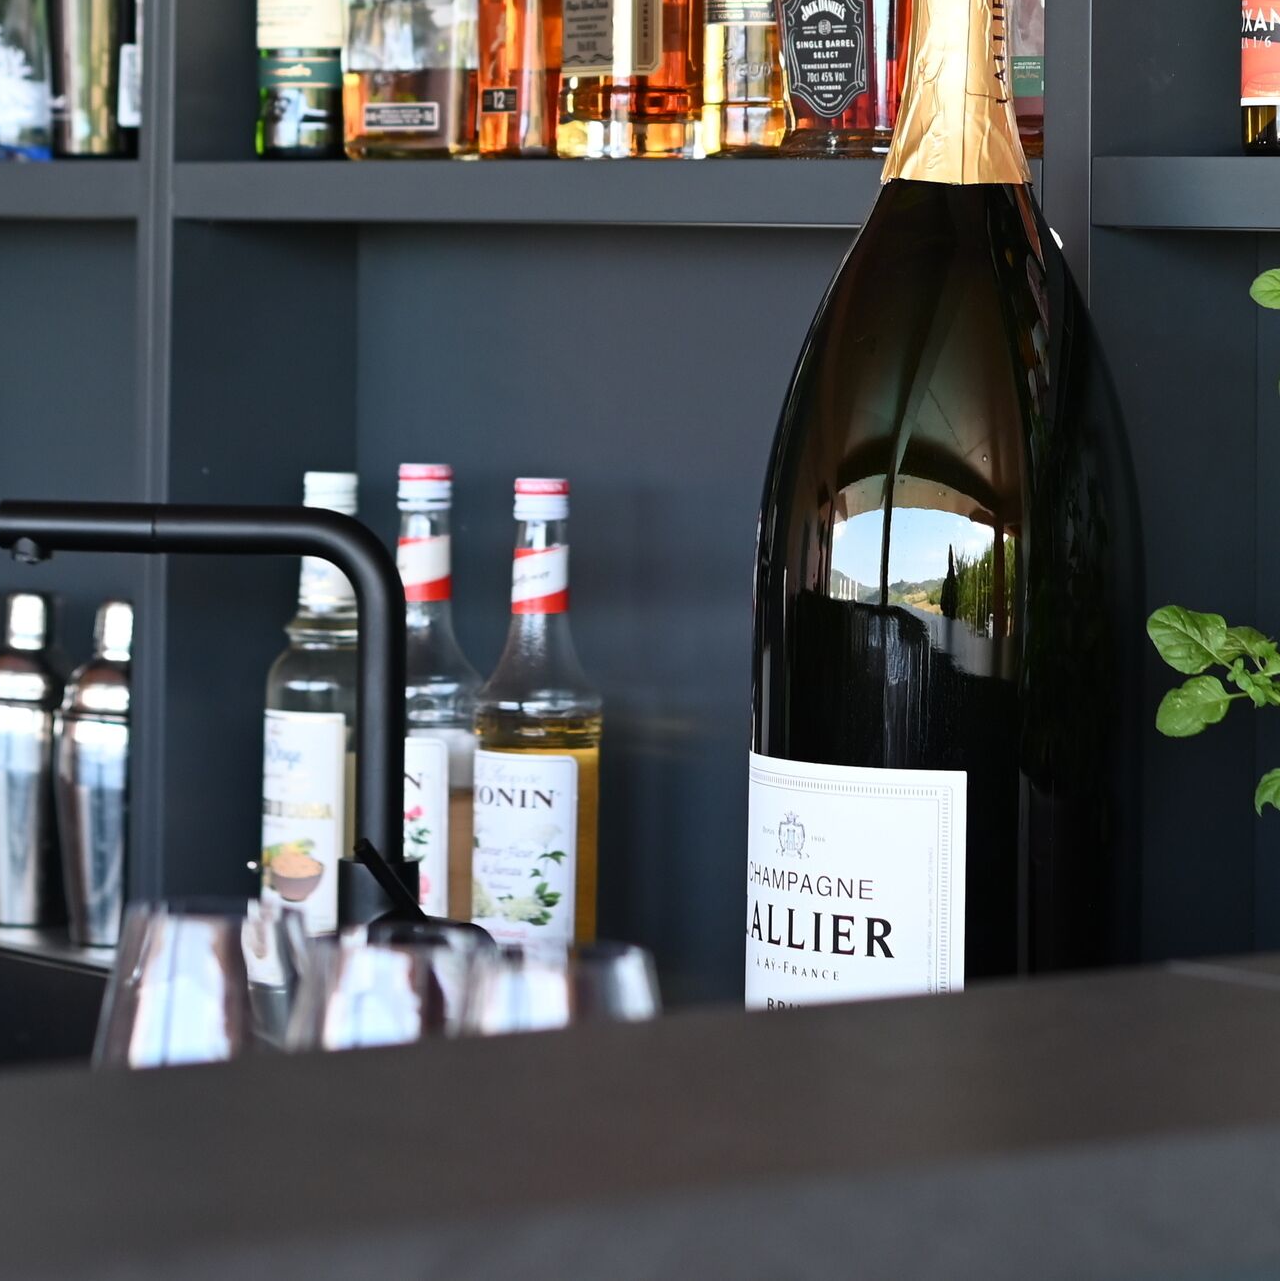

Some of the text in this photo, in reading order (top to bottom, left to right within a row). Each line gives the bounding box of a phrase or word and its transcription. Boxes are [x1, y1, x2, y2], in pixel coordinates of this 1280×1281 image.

[801, 0, 819, 21] JACK
[796, 39, 855, 49] SINGLE BARREL
[813, 51, 839, 59] SELECT
[493, 91, 505, 109] 12
[475, 785, 554, 809] ONIN
[748, 900, 895, 959] ALLIER
